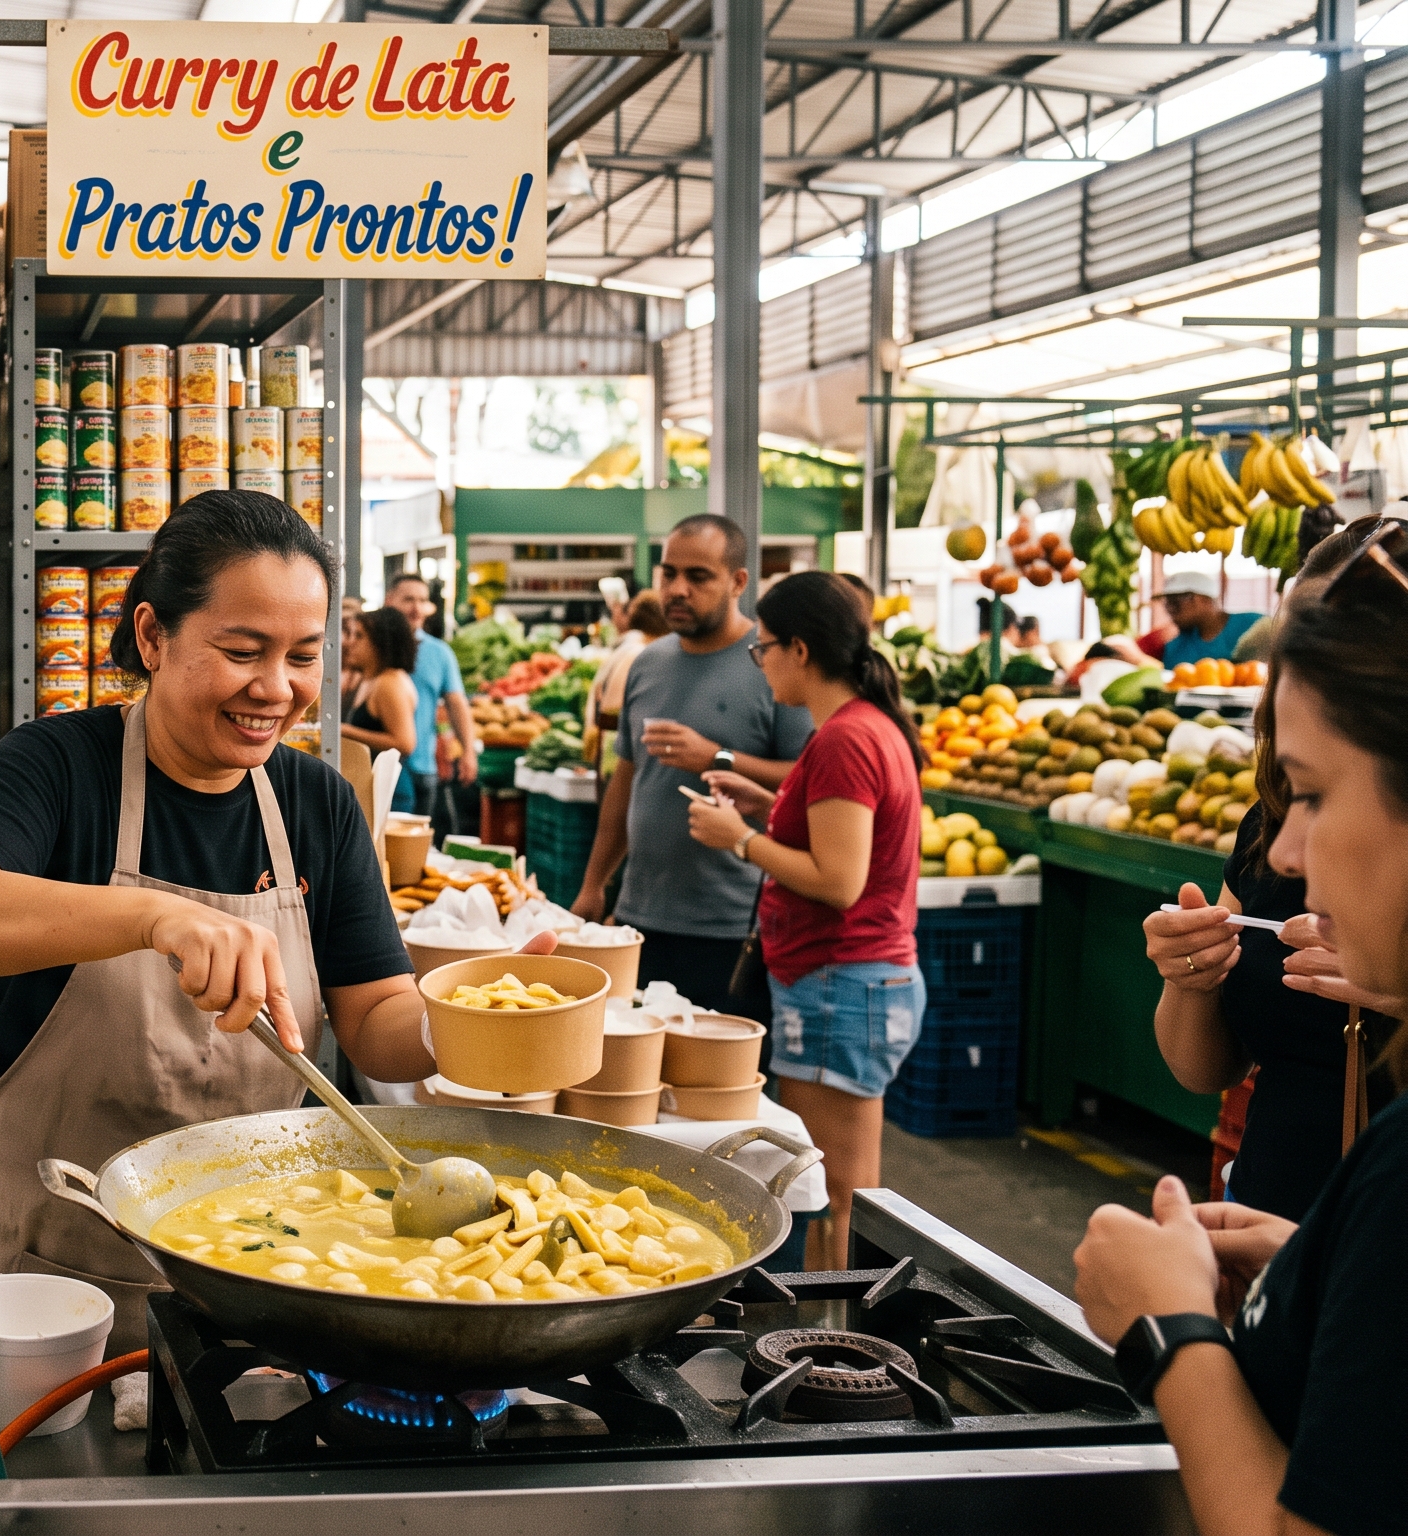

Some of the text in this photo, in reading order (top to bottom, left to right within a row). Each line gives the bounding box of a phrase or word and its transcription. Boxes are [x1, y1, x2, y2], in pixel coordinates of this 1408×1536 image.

[73, 31, 515, 138] Curry de Lata
[263, 130, 304, 174] e
[60, 173, 533, 265] Pratos Prontos!
